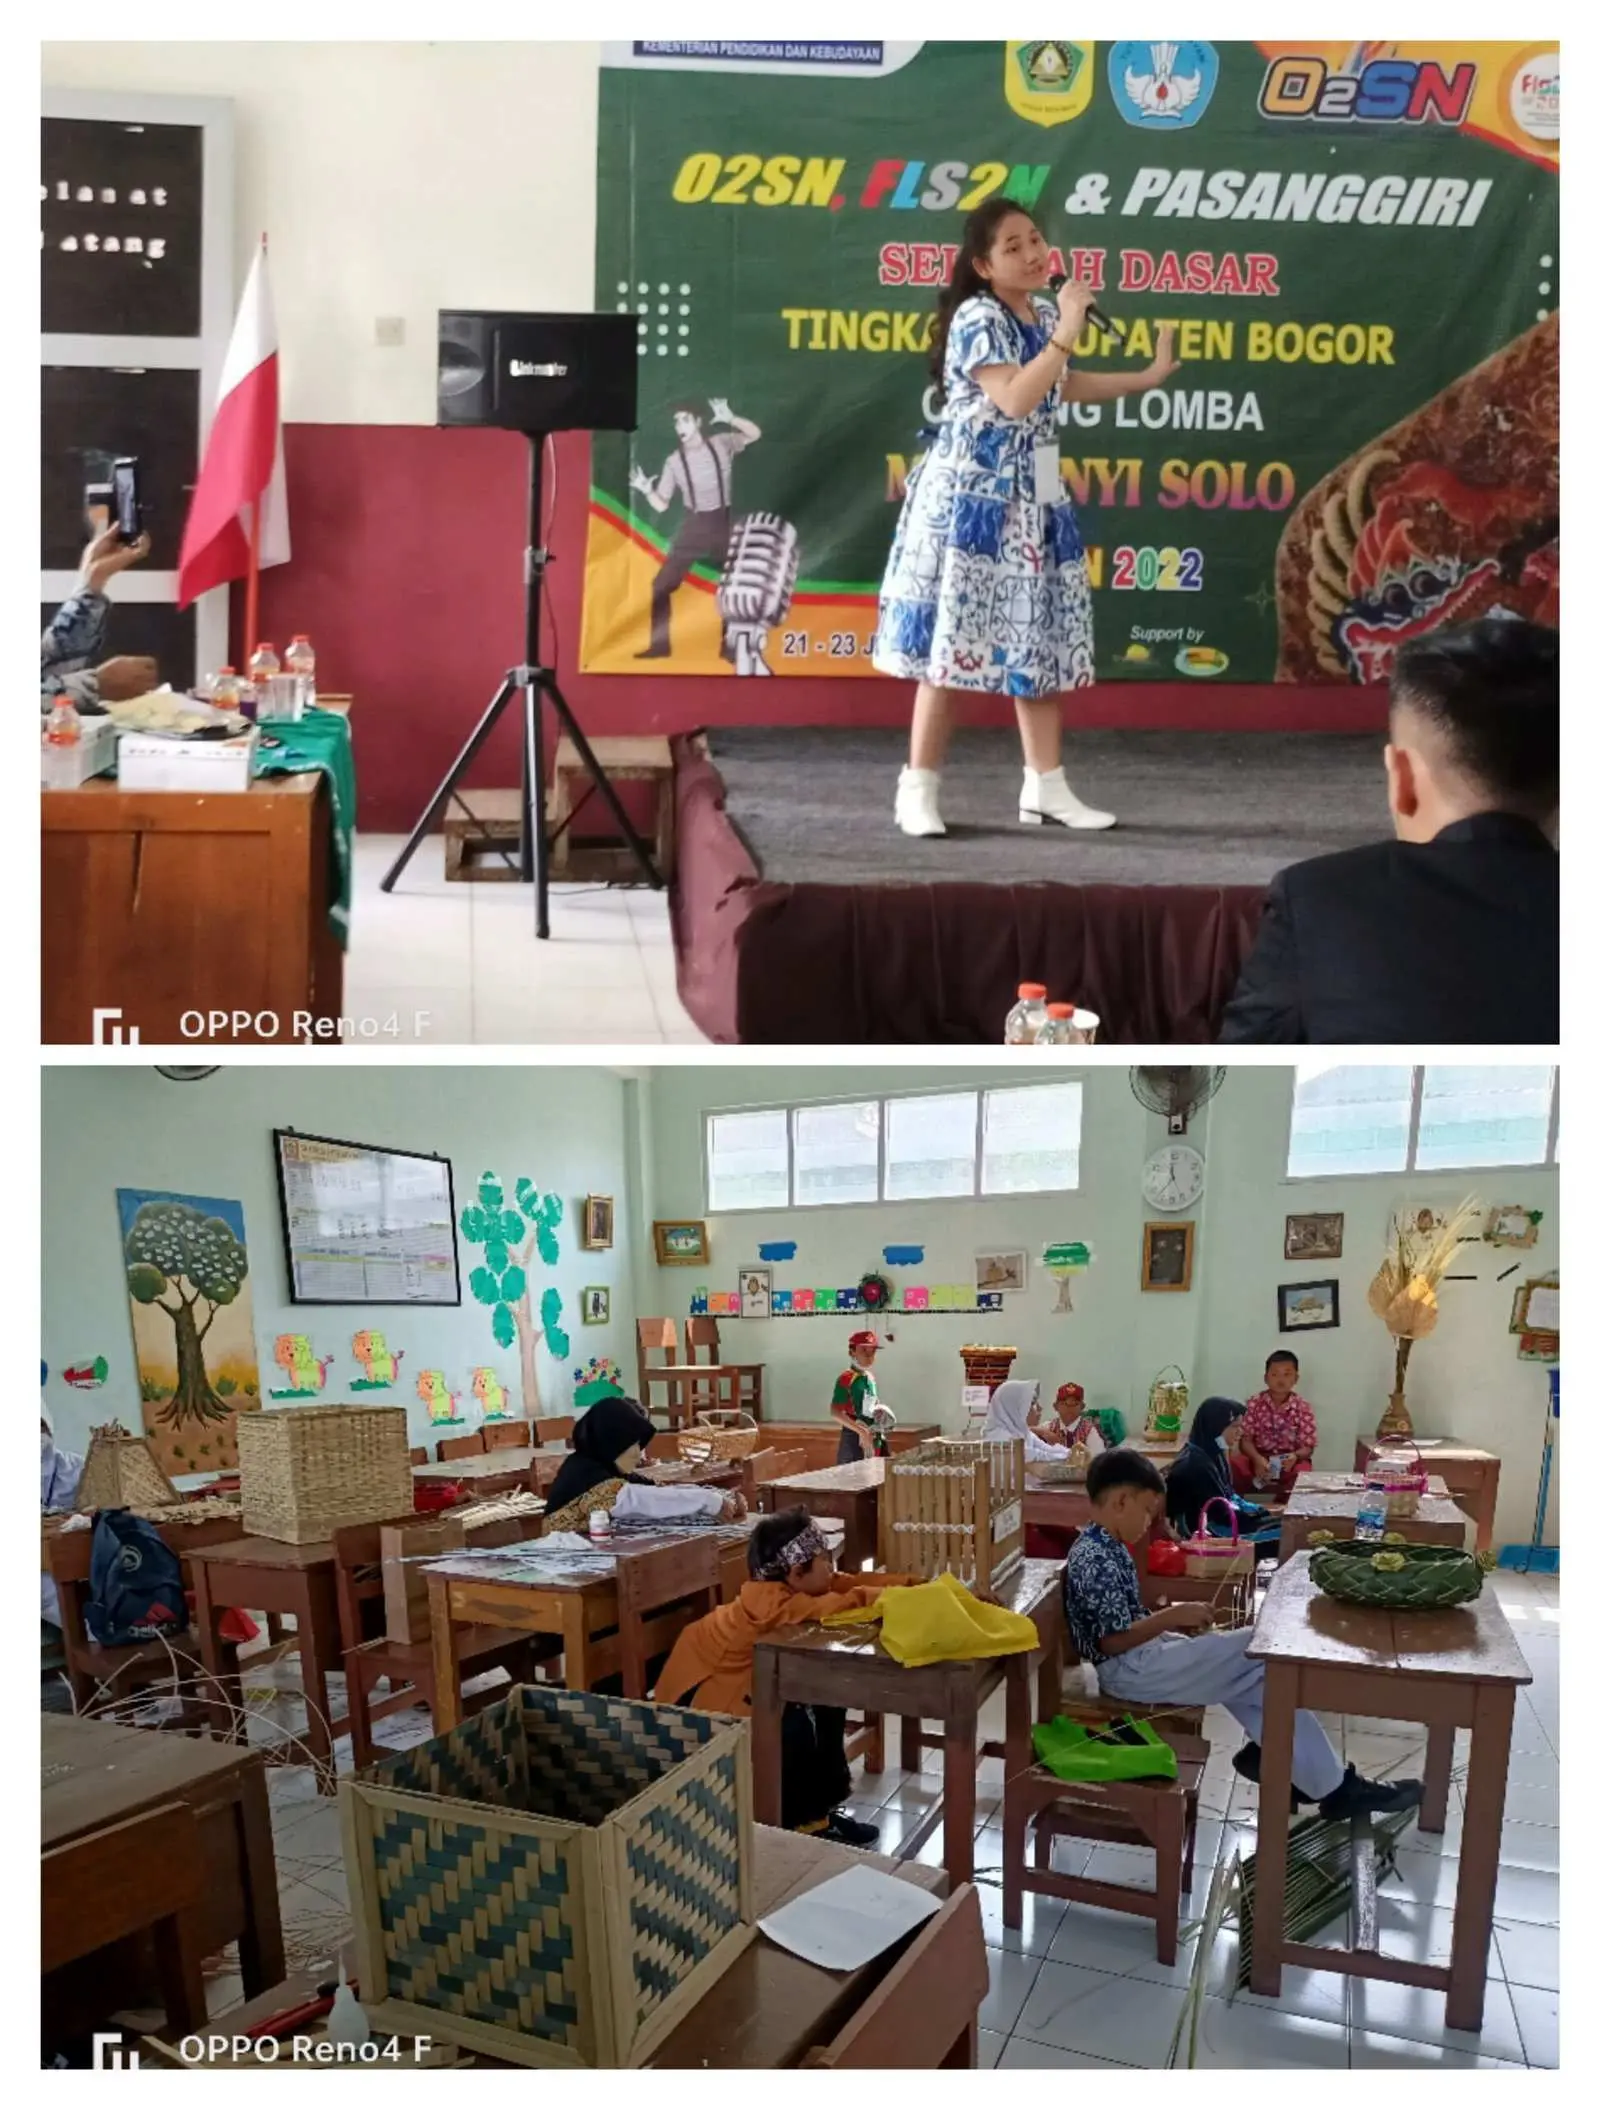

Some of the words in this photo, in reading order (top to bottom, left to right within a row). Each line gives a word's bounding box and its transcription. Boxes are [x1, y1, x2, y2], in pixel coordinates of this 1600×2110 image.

[642, 40, 718, 55] KEMENTERIAN
[719, 43, 784, 58] PENDIDIKAN
[784, 46, 808, 59] DAN
[809, 46, 881, 61] KEBUDAYAAN
[1065, 172, 1111, 216] &
[1120, 167, 1493, 228] PASANGGIRI
[1118, 248, 1280, 296] DASAR
[1248, 321, 1395, 366] BOGOR
[1115, 389, 1264, 432] LOMBA
[1159, 458, 1296, 511] SOLO
[1112, 546, 1203, 592] 2022
[783, 631, 808, 657] 21
[830, 632, 857, 657] 23
[1130, 625, 1184, 643] Support
[1186, 626, 1205, 644] by
